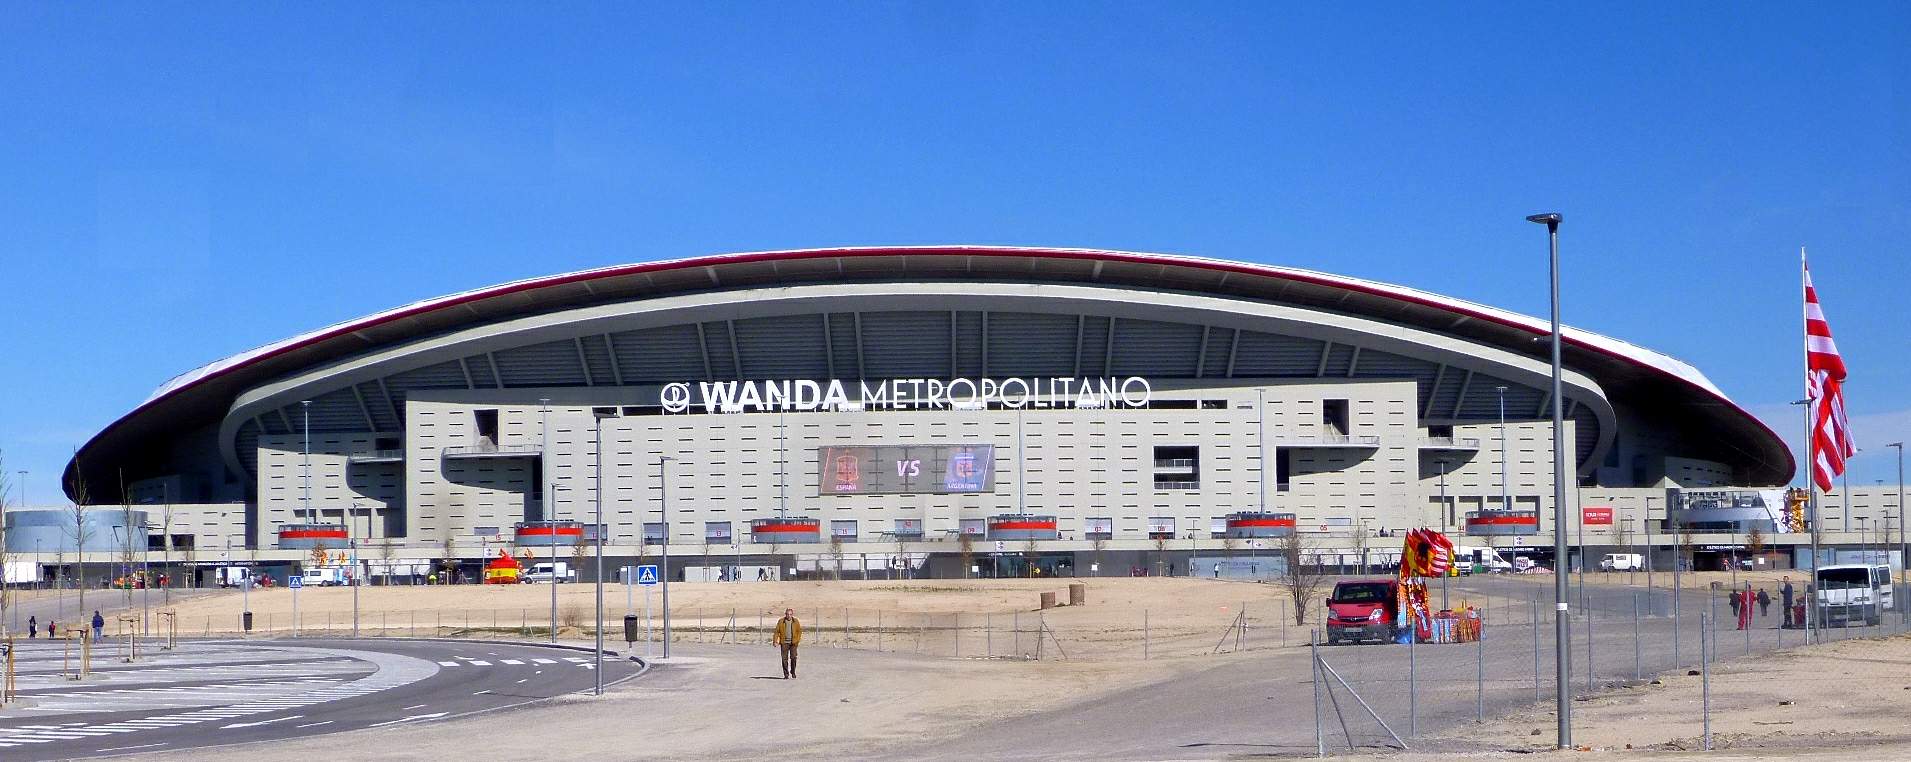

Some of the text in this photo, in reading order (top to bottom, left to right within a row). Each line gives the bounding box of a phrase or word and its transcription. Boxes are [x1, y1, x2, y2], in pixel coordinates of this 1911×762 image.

[700, 376, 1151, 411] WANDA METROPOLITANO
[897, 460, 920, 476] VS
